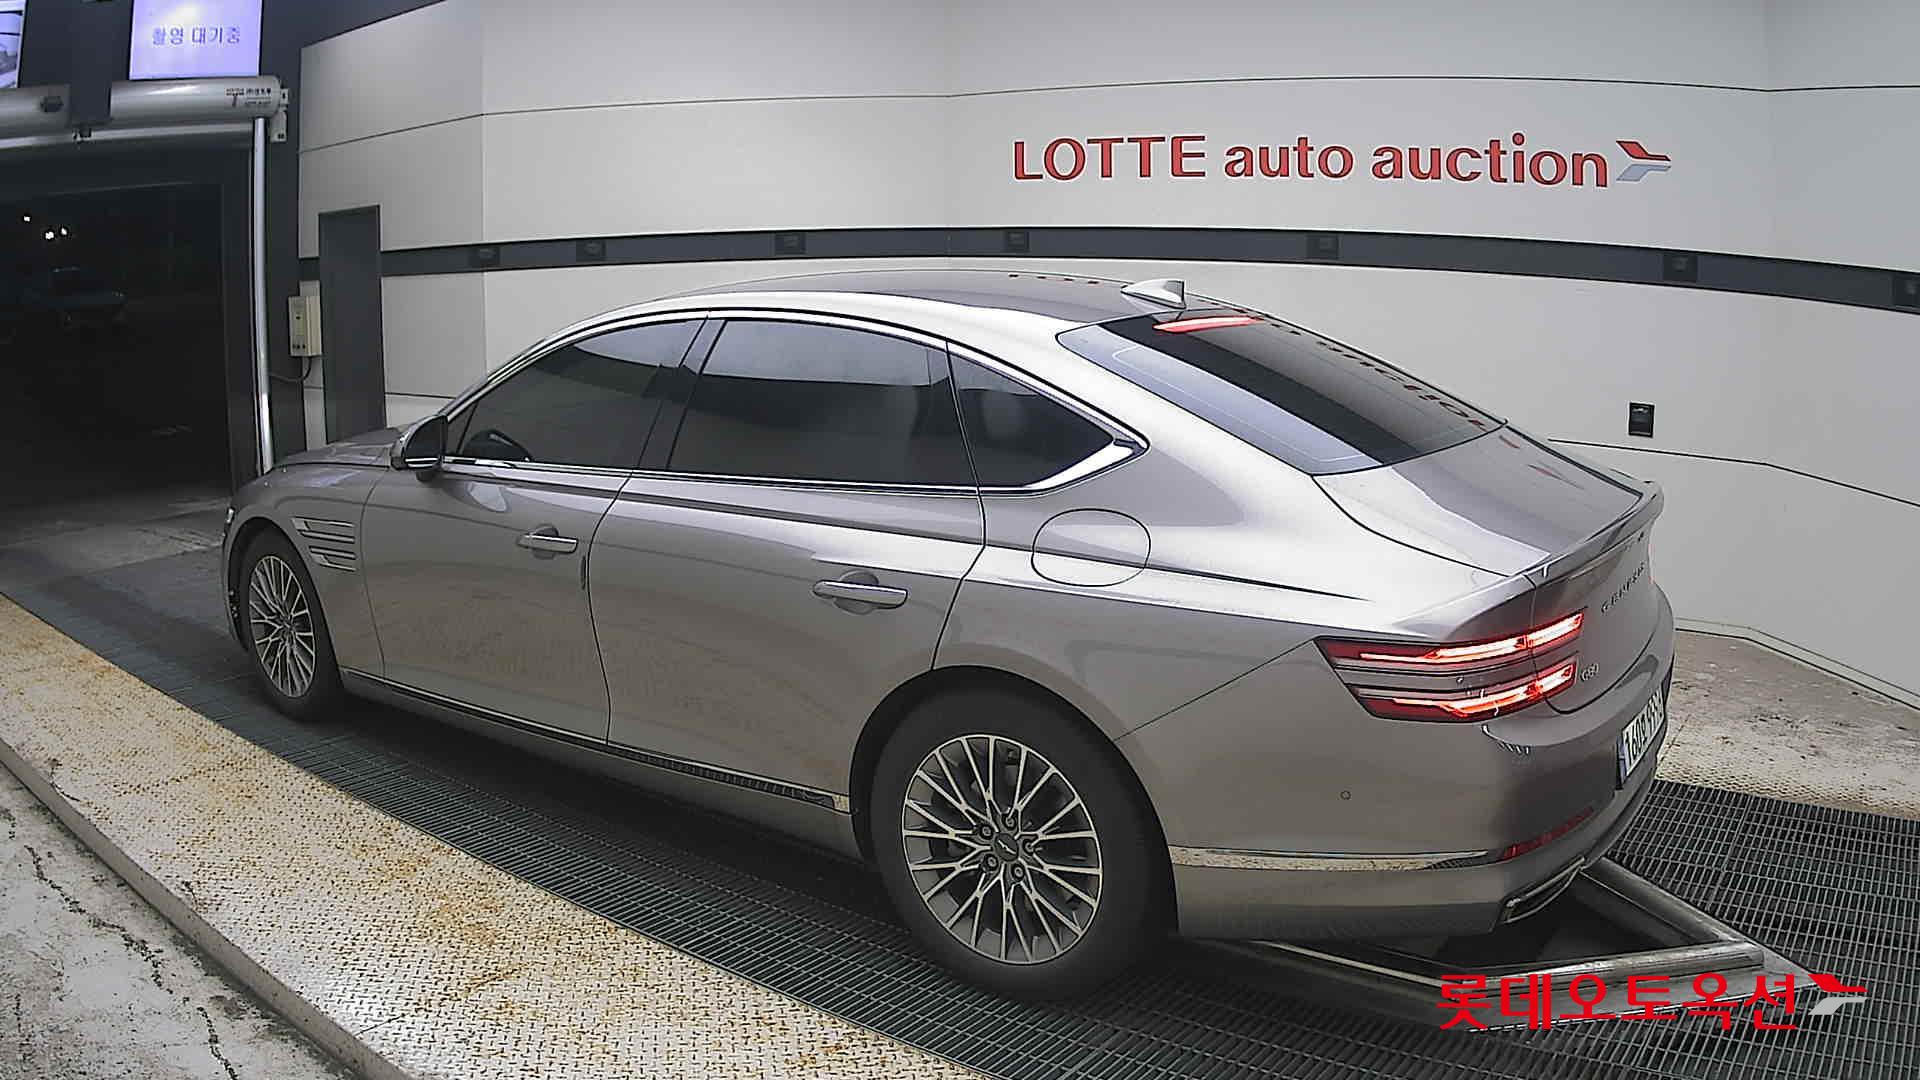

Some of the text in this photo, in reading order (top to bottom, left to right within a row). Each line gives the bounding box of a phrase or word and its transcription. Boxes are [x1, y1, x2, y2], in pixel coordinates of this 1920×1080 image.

[191, 26, 241, 44] 대기중
[1013, 132, 1608, 188] LOTTE auto auction
